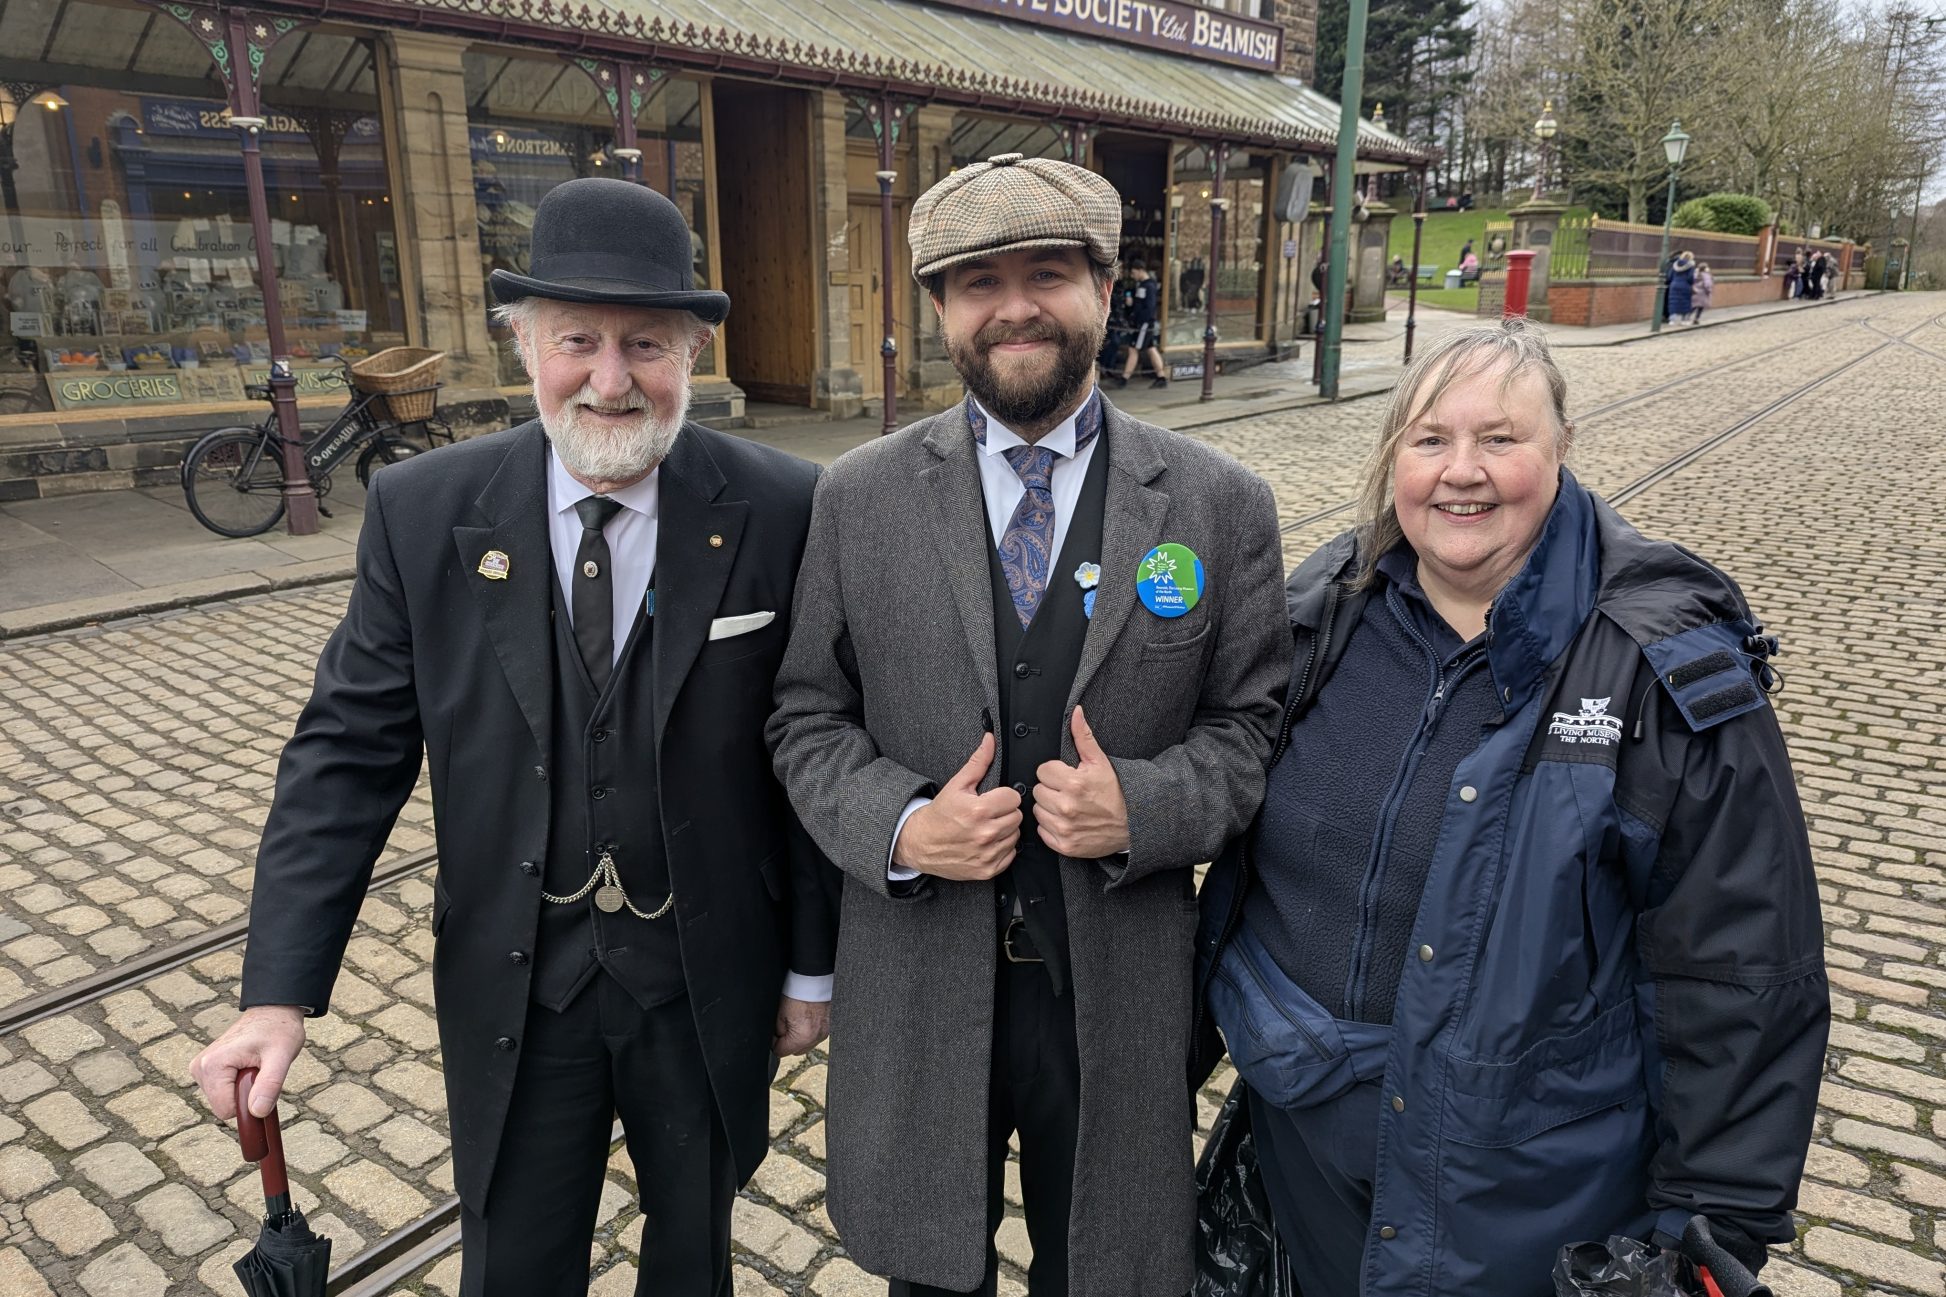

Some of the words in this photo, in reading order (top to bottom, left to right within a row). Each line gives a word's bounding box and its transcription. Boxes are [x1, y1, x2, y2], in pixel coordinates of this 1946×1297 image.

[1161, 14, 1188, 42] Ltd.
[1191, 9, 1278, 62] BEAMISH
[54, 231, 104, 255] Perfect
[140, 237, 159, 252] all
[169, 234, 241, 253] Cbration
[62, 378, 177, 401] GROCERIES
[1155, 595, 1184, 604] WINNER
[1553, 727, 1583, 737] LIVING
[1560, 735, 1577, 743] THE
[1580, 736, 1610, 746] NORTH
